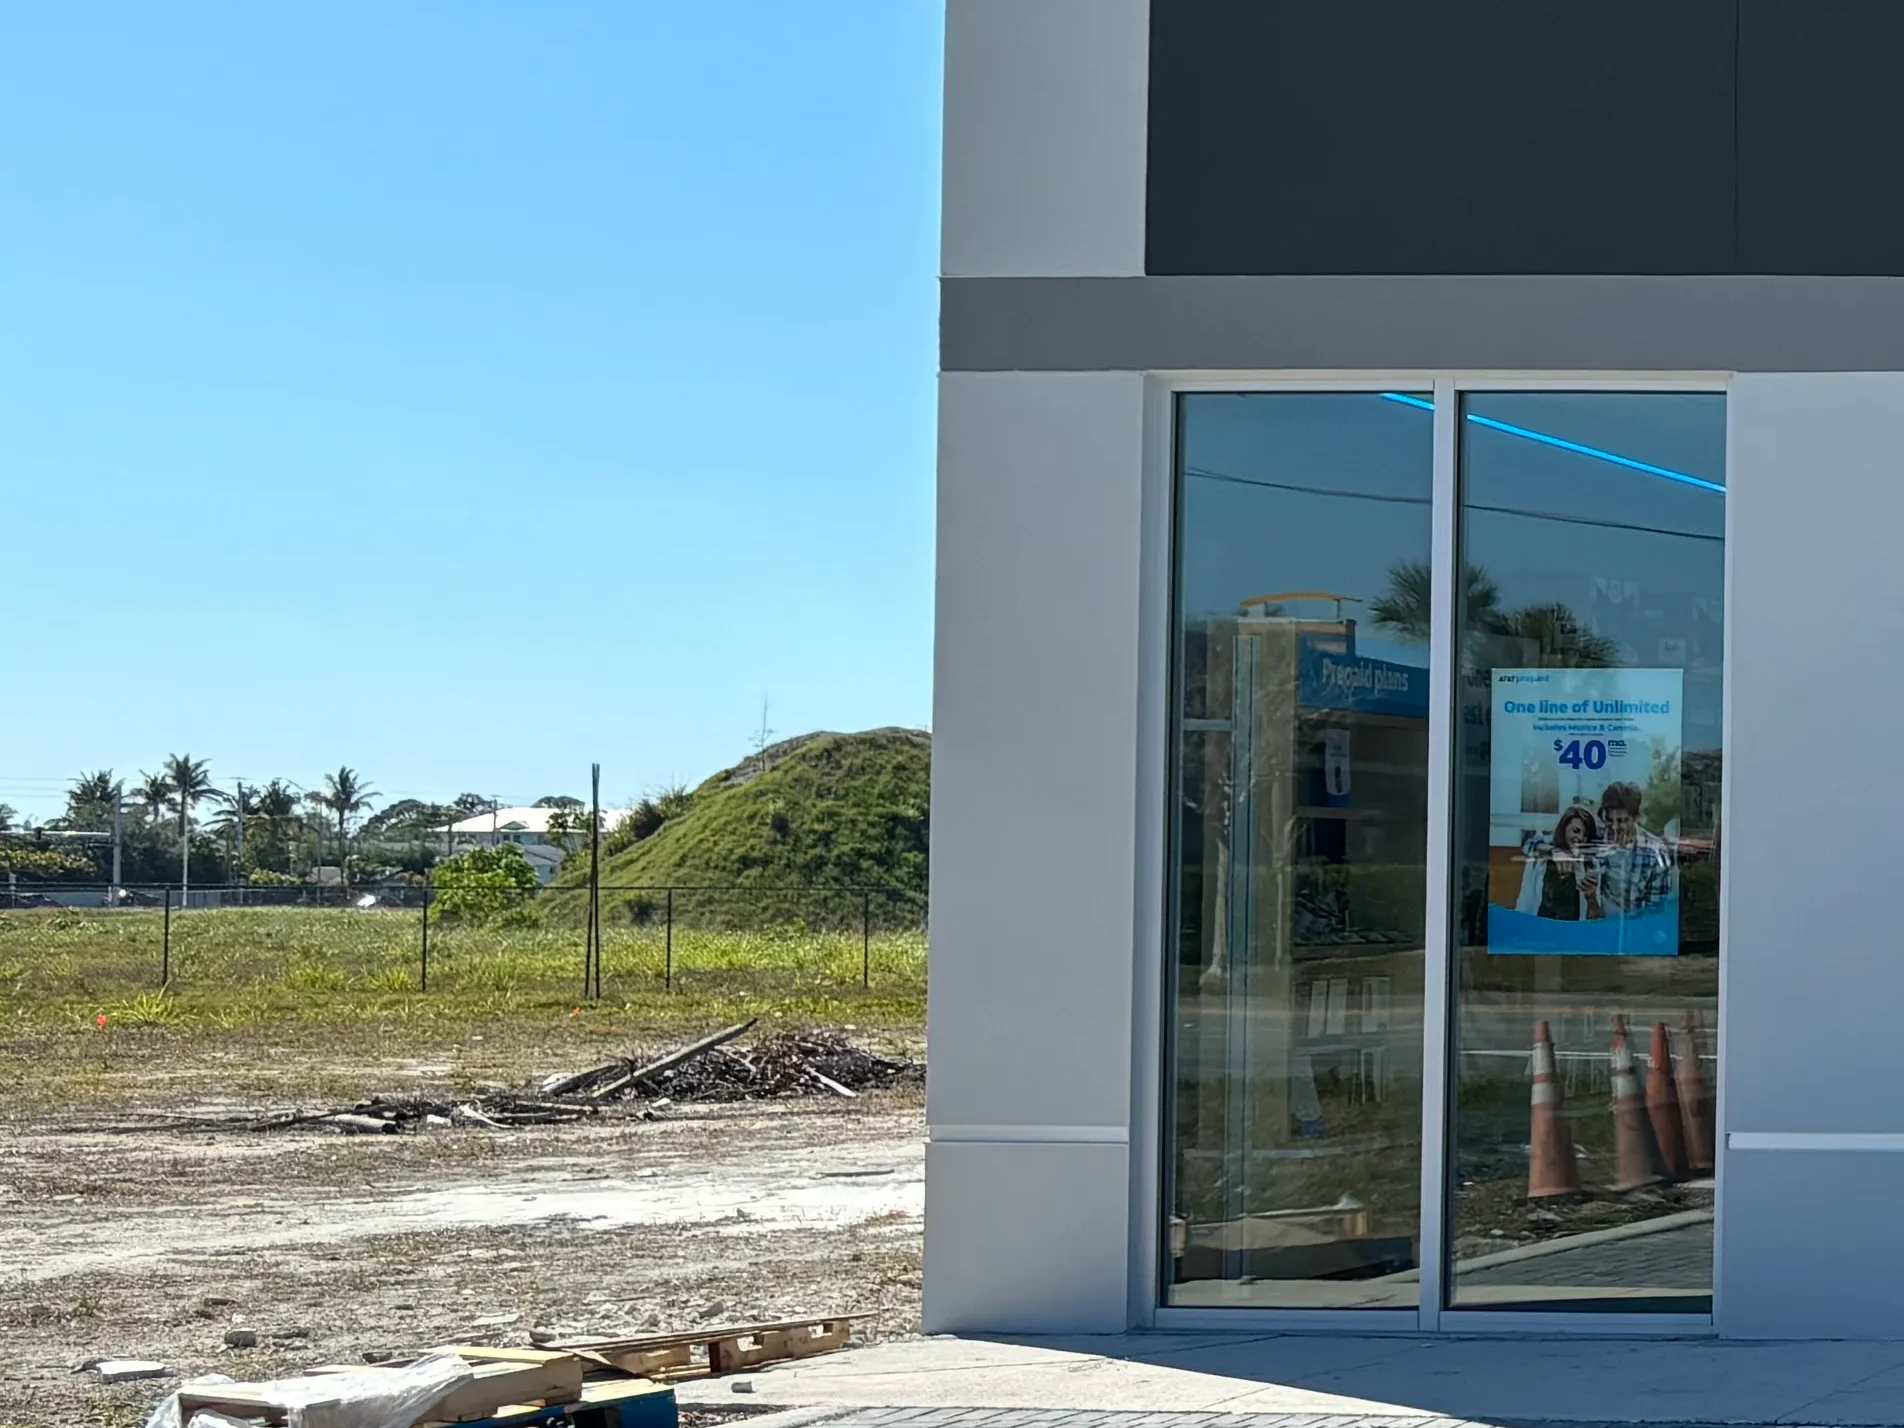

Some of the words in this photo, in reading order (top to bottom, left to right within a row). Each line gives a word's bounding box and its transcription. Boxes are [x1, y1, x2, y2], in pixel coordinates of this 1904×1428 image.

[1322, 658, 1374, 695] Prepaid
[1374, 662, 1409, 697] plans
[1503, 700, 1536, 715] One
[1539, 699, 1573, 715] line
[1574, 699, 1589, 715] of
[1592, 699, 1671, 715] Unlimited
